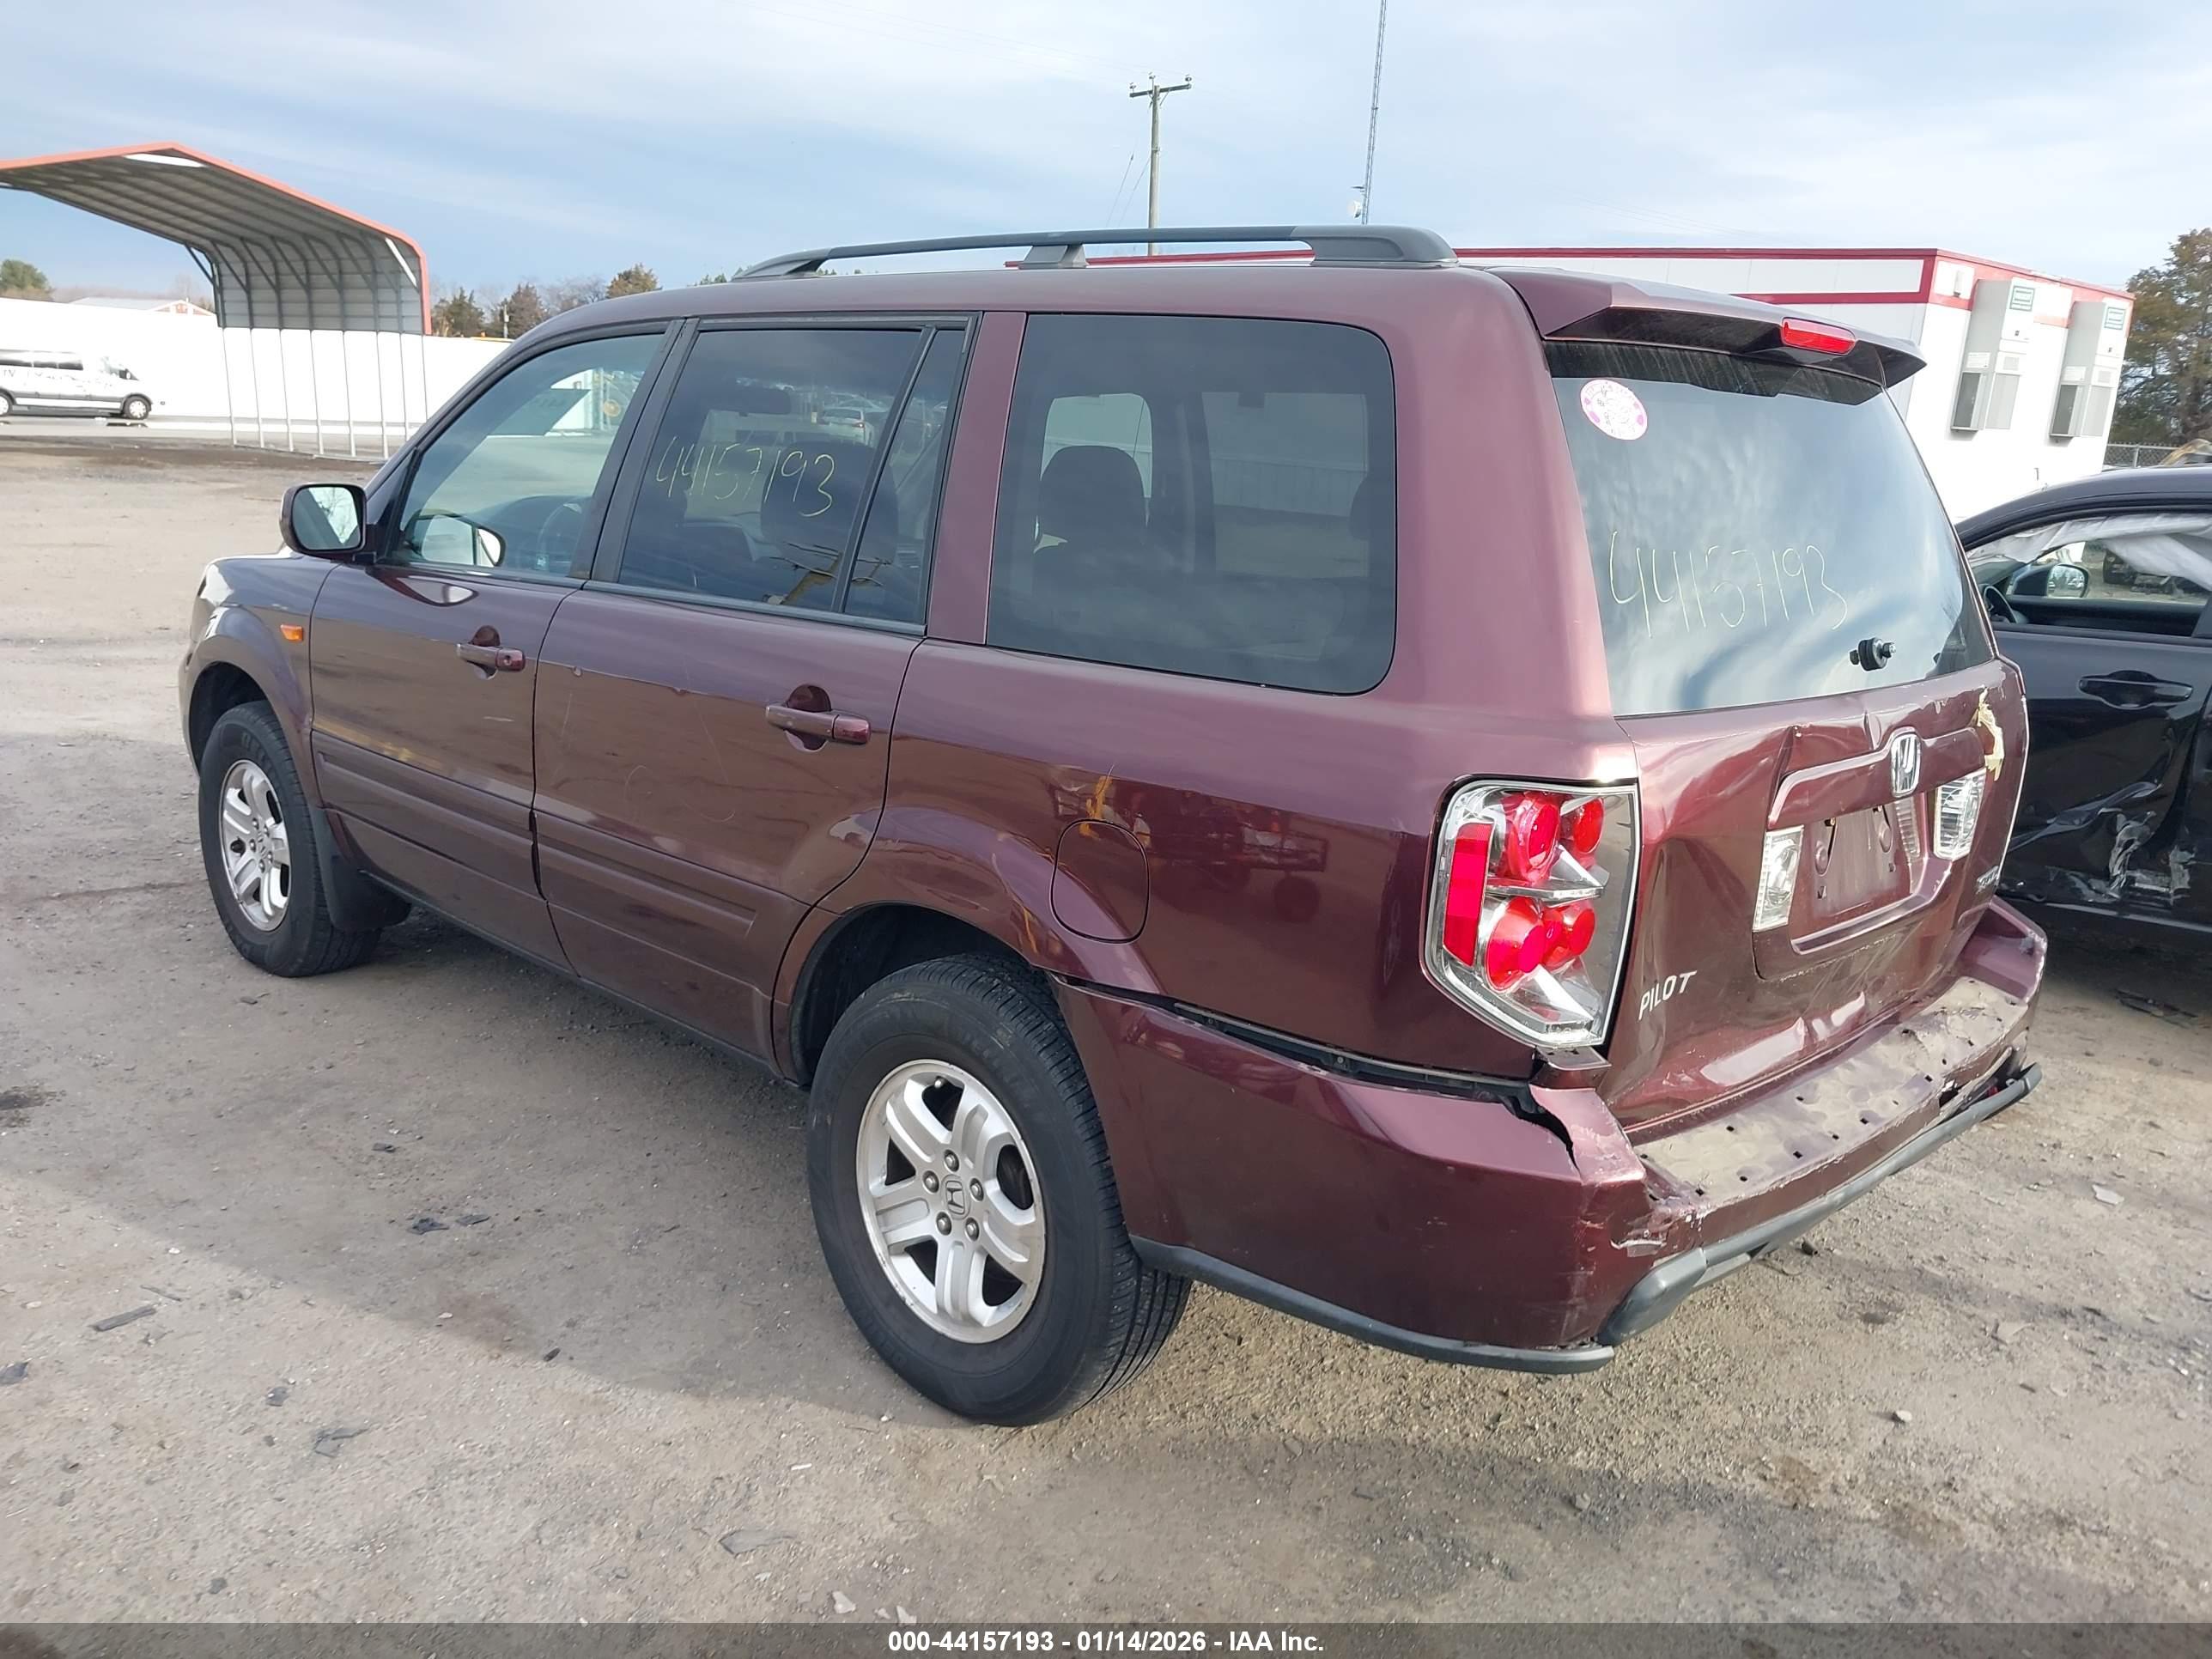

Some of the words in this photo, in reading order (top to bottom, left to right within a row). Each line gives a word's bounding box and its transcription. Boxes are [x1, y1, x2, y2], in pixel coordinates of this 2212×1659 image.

[655, 435, 836, 517] 44157193
[1609, 531, 1848, 638] 44157193
[1638, 969, 1698, 1021] PILOT
